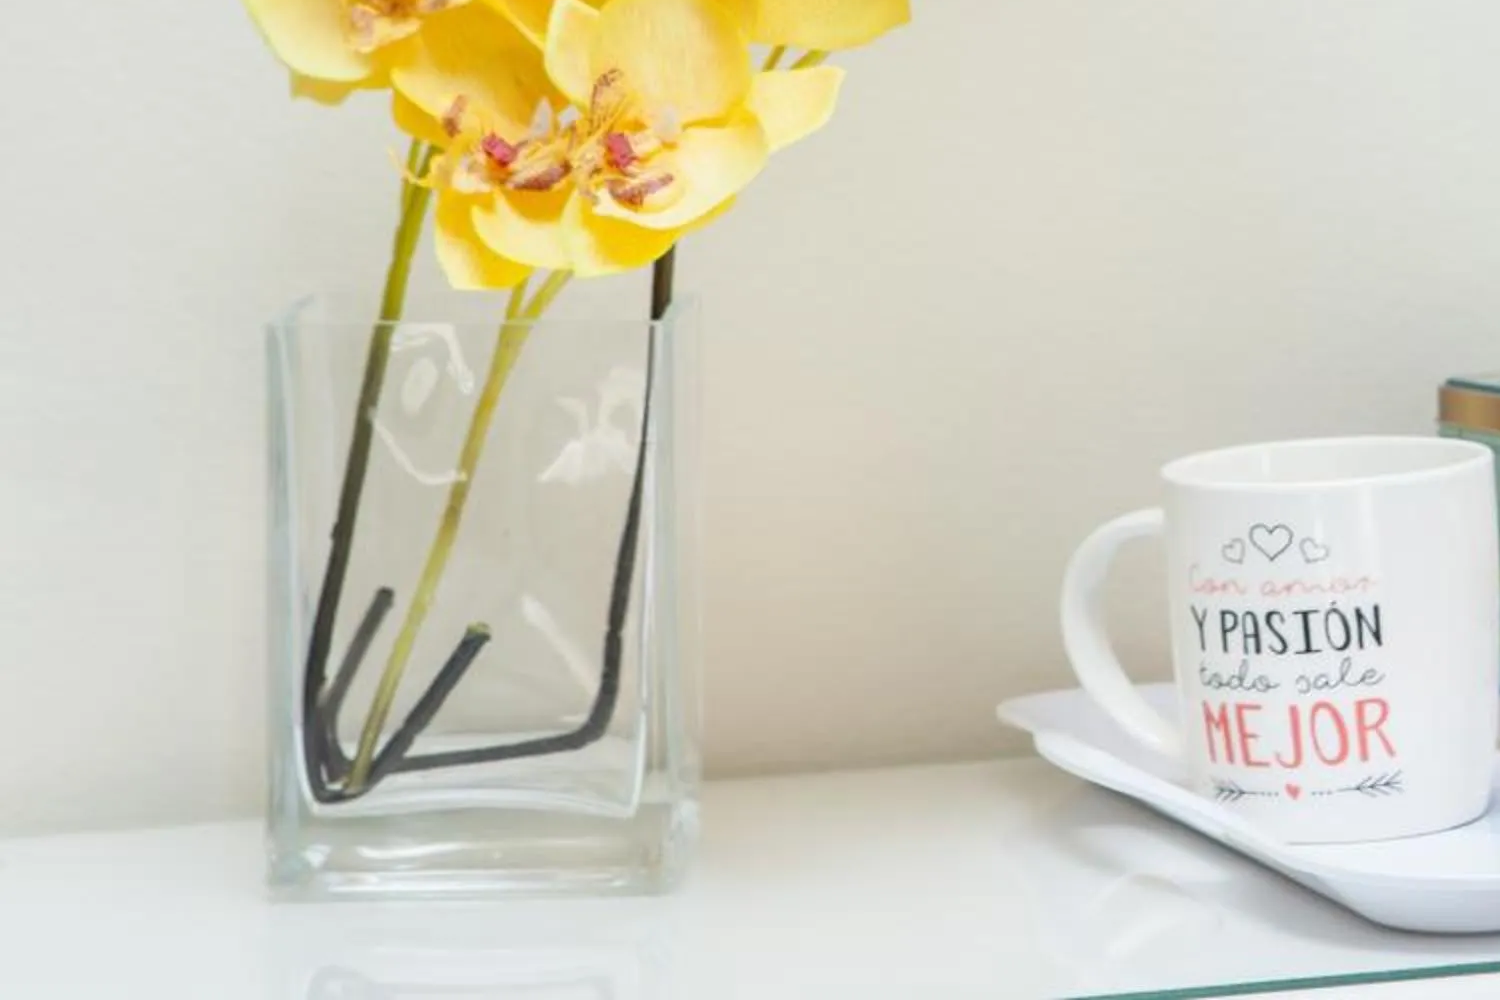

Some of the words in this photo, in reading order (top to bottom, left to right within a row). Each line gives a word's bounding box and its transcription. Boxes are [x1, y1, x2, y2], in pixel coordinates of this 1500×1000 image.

[1188, 562, 1248, 595] Con
[1190, 603, 1208, 652] Y
[1219, 600, 1384, 655] PASIÓN
[1199, 657, 1281, 693] todo
[1295, 656, 1386, 694] sale
[1201, 696, 1397, 770] MEJOR
